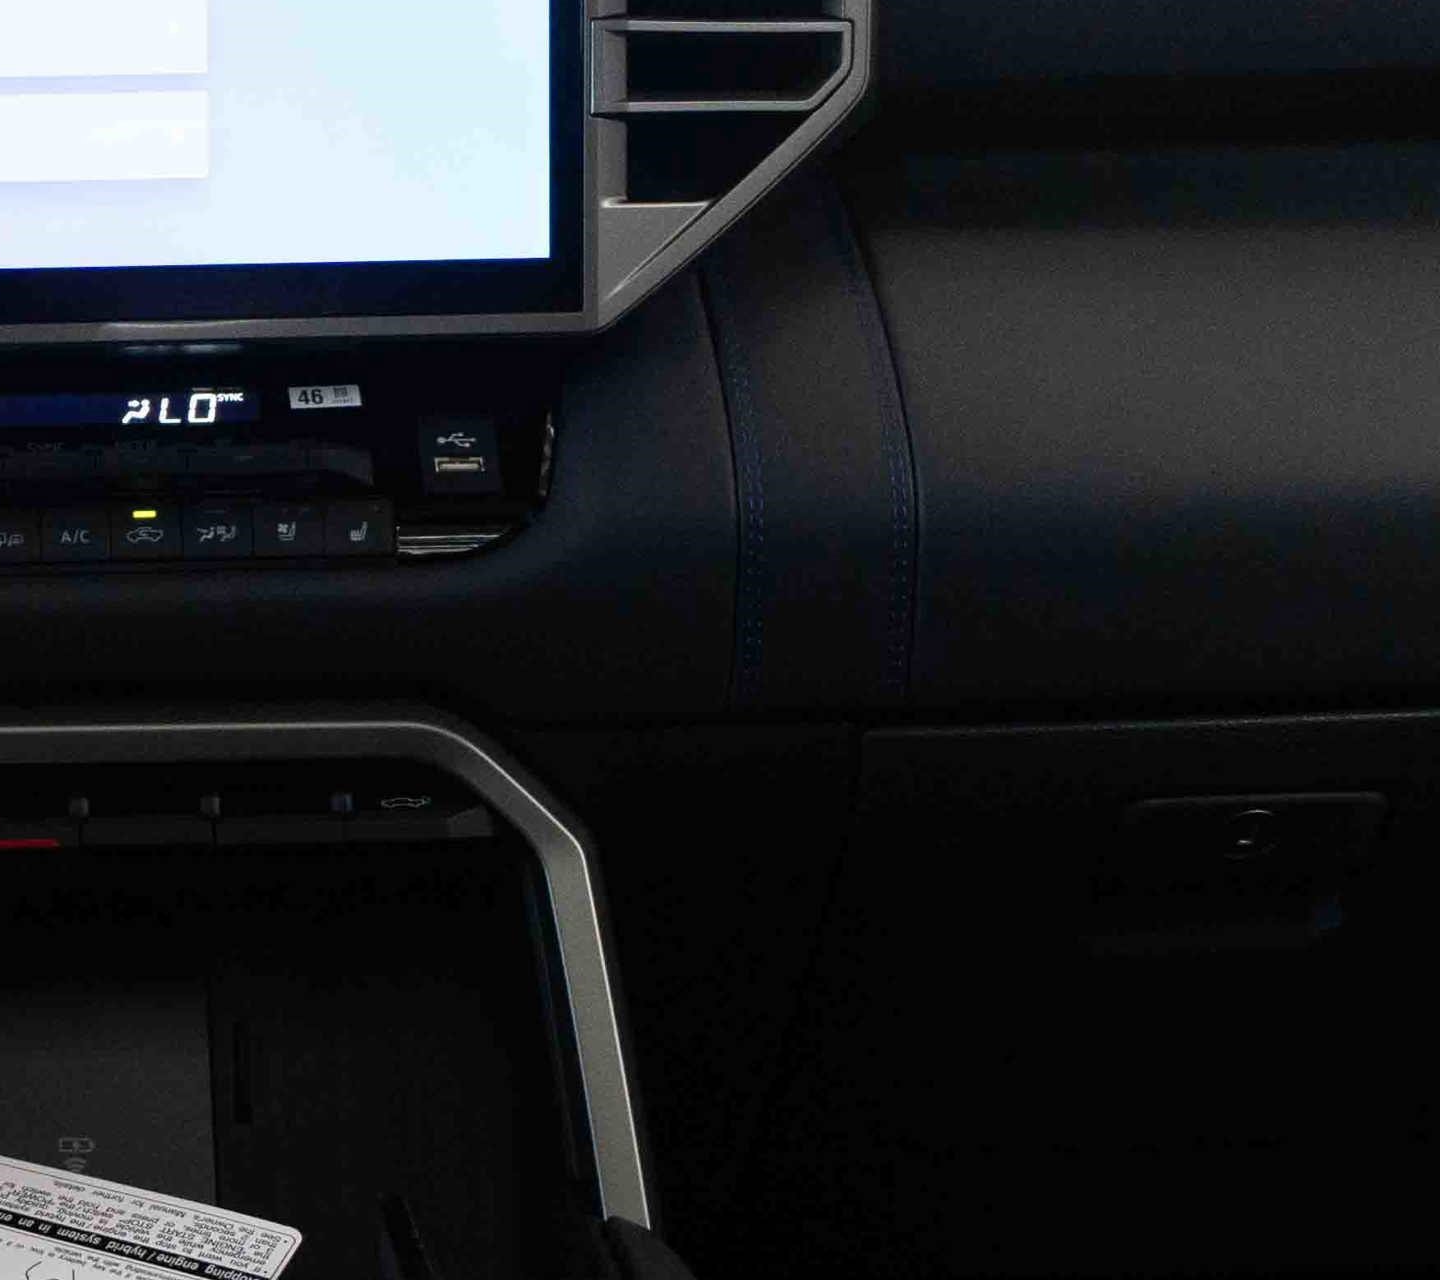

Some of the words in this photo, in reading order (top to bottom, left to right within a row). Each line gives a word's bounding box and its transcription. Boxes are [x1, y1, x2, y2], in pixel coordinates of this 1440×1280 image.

[297, 389, 324, 405] 46
[157, 392, 217, 426] LO
[216, 389, 244, 402] SYNC
[58, 527, 92, 545] A/C
[15, 1217, 35, 1228] an
[35, 1222, 52, 1233] in
[54, 1225, 103, 1246] system
[103, 1238, 148, 1259] hybrid
[153, 1251, 200, 1273] engine
